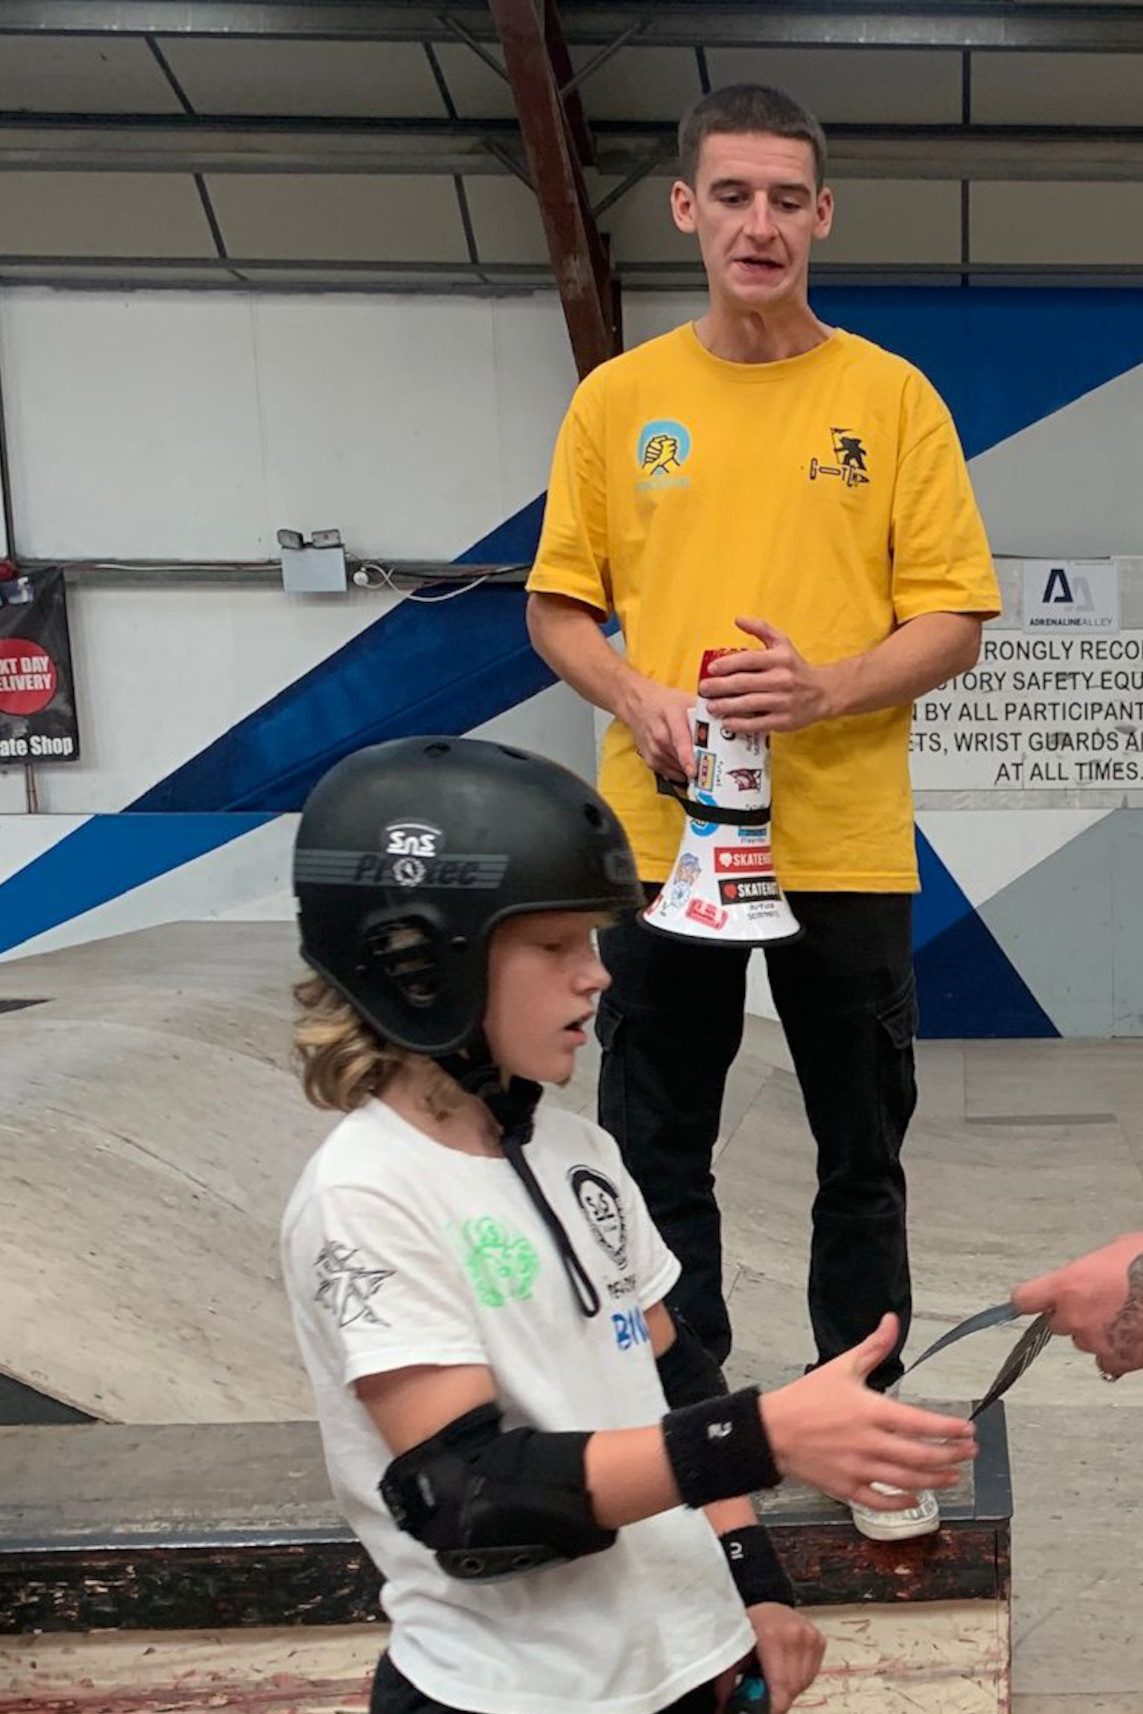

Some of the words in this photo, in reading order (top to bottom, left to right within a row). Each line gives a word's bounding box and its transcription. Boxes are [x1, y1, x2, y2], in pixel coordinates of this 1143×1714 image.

[984, 640, 1074, 660] RONGLY
[20, 656, 49, 674] DAY
[936, 671, 1007, 691] TORY
[1012, 671, 1094, 691] SAFETY
[925, 702, 952, 721] BY
[958, 702, 998, 721] ALL
[0, 738, 28, 757] ate
[30, 735, 73, 756] Shop
[954, 732, 1022, 752] WRIST
[1028, 731, 1119, 751] GUARDS
[997, 762, 1025, 782] AT
[1030, 762, 1069, 781] ALL
[1075, 761, 1143, 780] TIMES.
